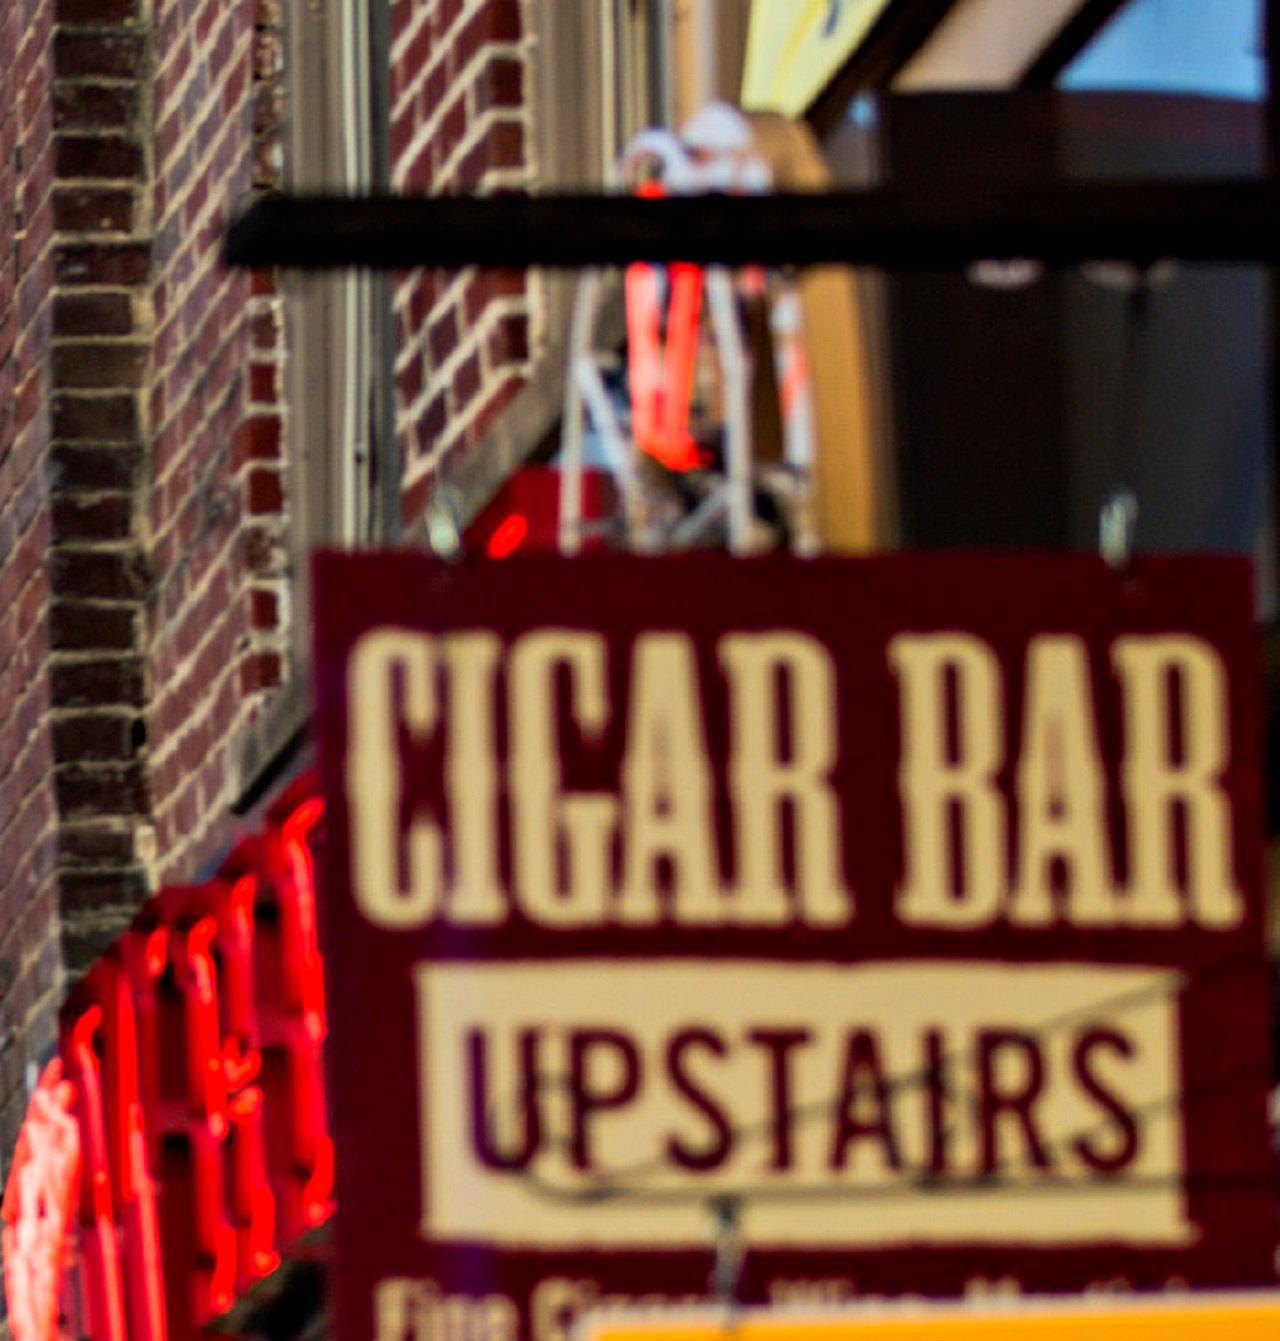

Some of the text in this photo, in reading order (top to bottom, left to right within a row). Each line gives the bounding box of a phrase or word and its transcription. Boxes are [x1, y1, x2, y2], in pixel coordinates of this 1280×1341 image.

[346, 626, 1243, 929] CIGAR BAR
[464, 1023, 1143, 1177] UPSTAIRS
